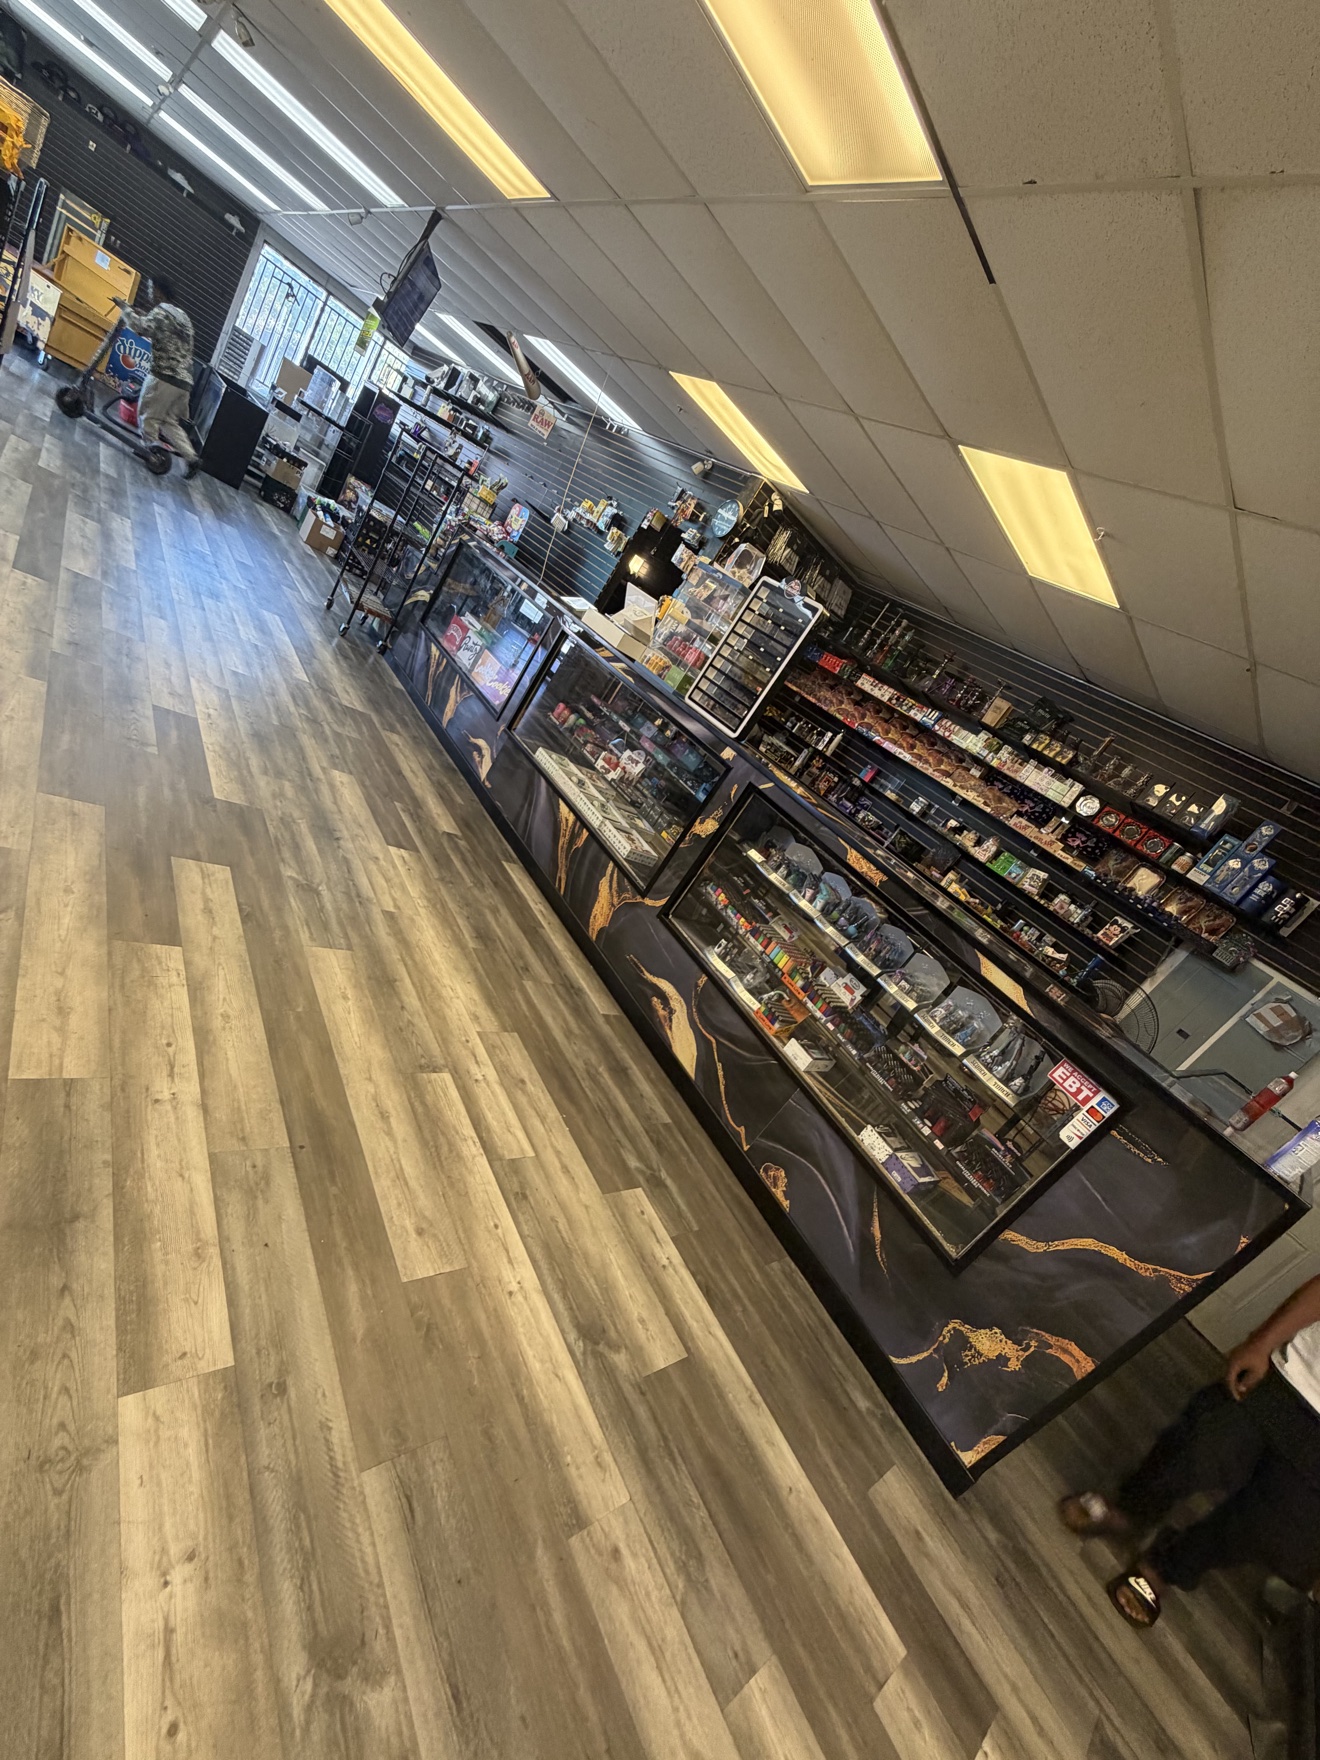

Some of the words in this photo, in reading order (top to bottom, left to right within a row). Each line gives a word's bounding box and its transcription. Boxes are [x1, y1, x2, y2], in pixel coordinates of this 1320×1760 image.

[532, 413, 553, 429] RAW
[487, 681, 511, 697] Cookie
[1052, 1066, 1094, 1101] EBT
[1063, 1062, 1074, 1073] WE
[1073, 1071, 1097, 1092] ACCEPT
[1081, 1117, 1093, 1129] VISA
[1135, 1577, 1157, 1600] NIKE
